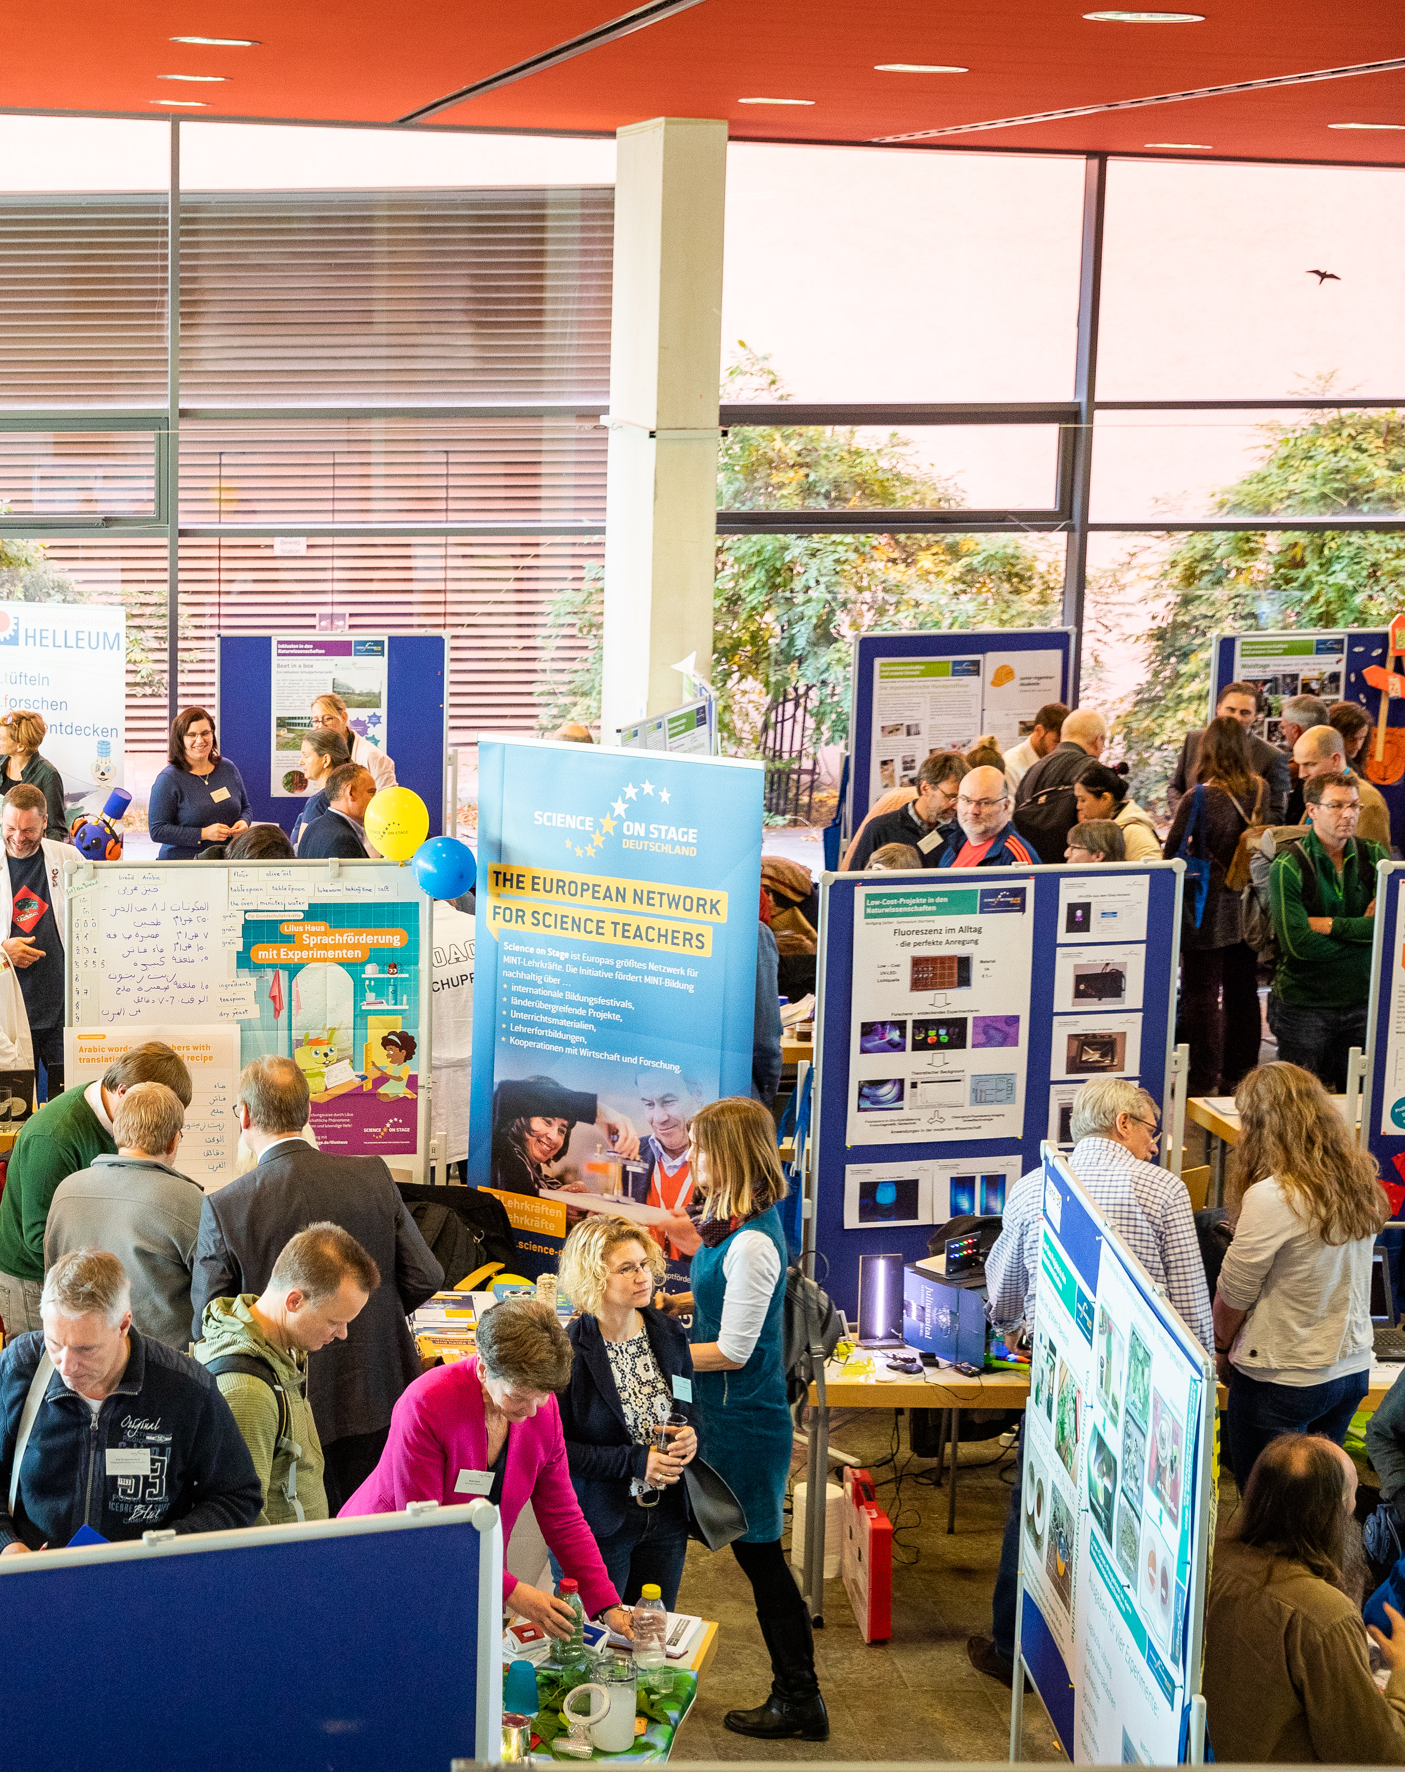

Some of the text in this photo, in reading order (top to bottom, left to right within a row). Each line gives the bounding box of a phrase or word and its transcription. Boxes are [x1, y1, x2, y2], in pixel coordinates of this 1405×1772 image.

[25, 628, 120, 651] HELLEUM
[534, 811, 697, 843] SCIENCE ON STAGE
[622, 838, 697, 857] DEUTSCHLAND
[231, 885, 263, 894] tablespoon
[272, 885, 305, 894] tablespoon
[493, 870, 721, 916] THE EUROPEAN NETWORK
[867, 898, 927, 907] Low-Cost-Projekte
[867, 905, 936, 914] Naturwissenschaften
[284, 924, 303, 932] Lilus
[493, 906, 705, 949] FOR SCIENCE TEACHERS
[894, 928, 942, 936] Fluoreszenz
[958, 926, 983, 934] Alltag
[303, 933, 400, 947] Sprachförderung
[913, 940, 943, 948] perfekte
[945, 938, 979, 946] Anregung
[259, 948, 361, 962] mit Experimenten
[503, 942, 534, 954] Science
[547, 948, 569, 960] Stage
[571, 950, 580, 959] ist
[582, 953, 614, 966] Europas
[616, 958, 647, 969] größtes
[648, 962, 685, 976] Netzwerk
[687, 968, 698, 977] für
[503, 955, 695, 993] MINT-Lehrkräfte. Die Initiative fördert MINT-Bildung
[503, 970, 561, 985] nachhaltig über
[219, 981, 251, 990] ingredients
[512, 983, 634, 1010] internationale Bildungsfestivals,
[511, 997, 623, 1022] länderübergreifende Projekte,
[511, 1010, 596, 1032] Unterrichtsmaterialien,
[510, 1024, 587, 1044] Lehrerfortbildungen,
[79, 1045, 105, 1053] Arabic
[187, 1054, 213, 1063] recipe
[510, 1036, 681, 1073] Kooperationen mit Wirtschaft und Forschung,
[925, 1286, 933, 1340] Juliusspital
[121, 1415, 161, 1437] Original
